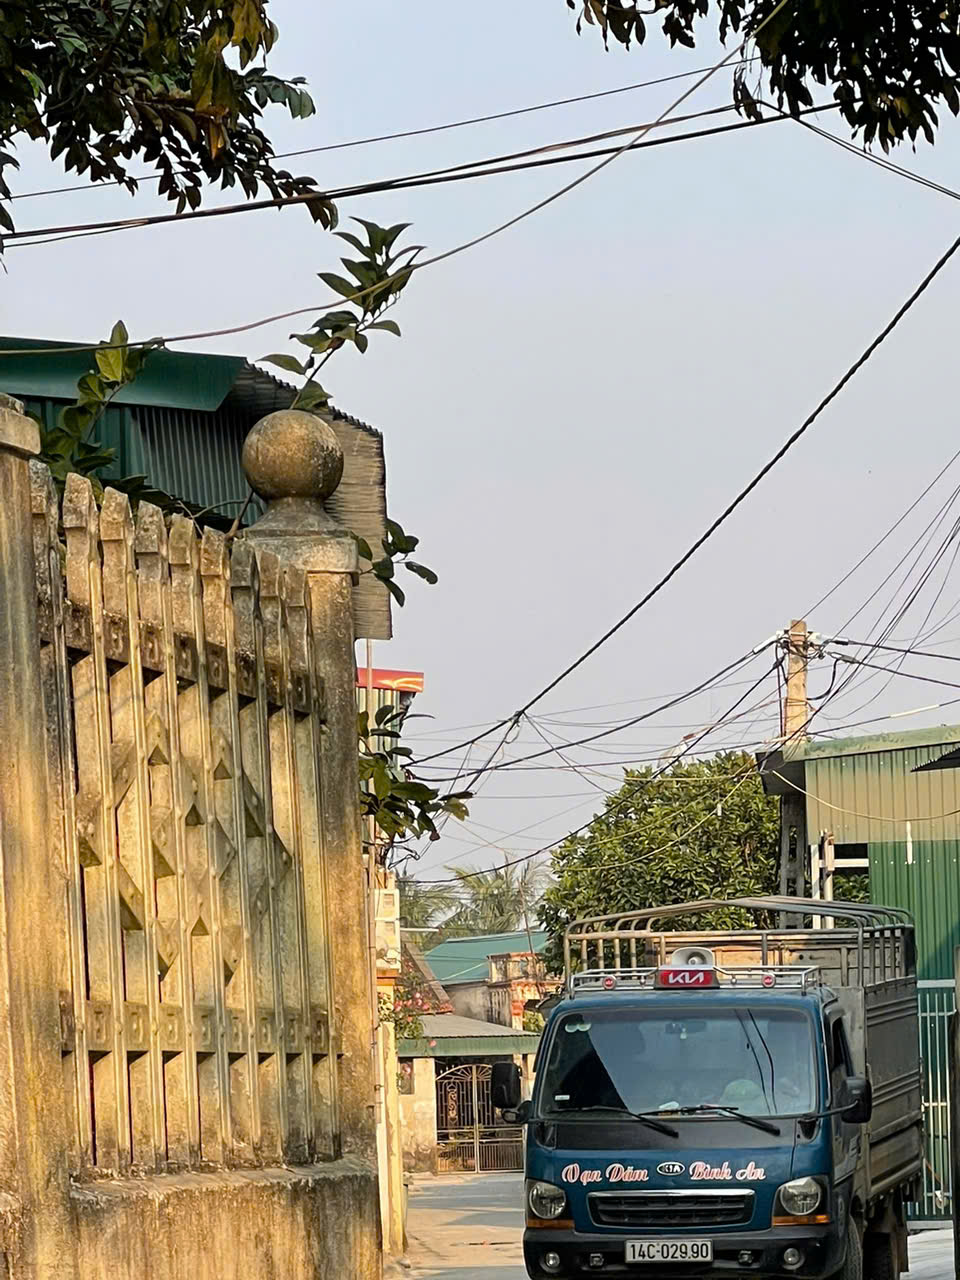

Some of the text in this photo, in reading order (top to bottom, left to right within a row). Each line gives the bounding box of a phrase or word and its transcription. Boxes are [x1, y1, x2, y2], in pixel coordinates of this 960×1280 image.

[660, 1163, 681, 1173] KIA
[735, 1161, 767, 1180] An
[630, 1243, 709, 1260] 14C-029.90
